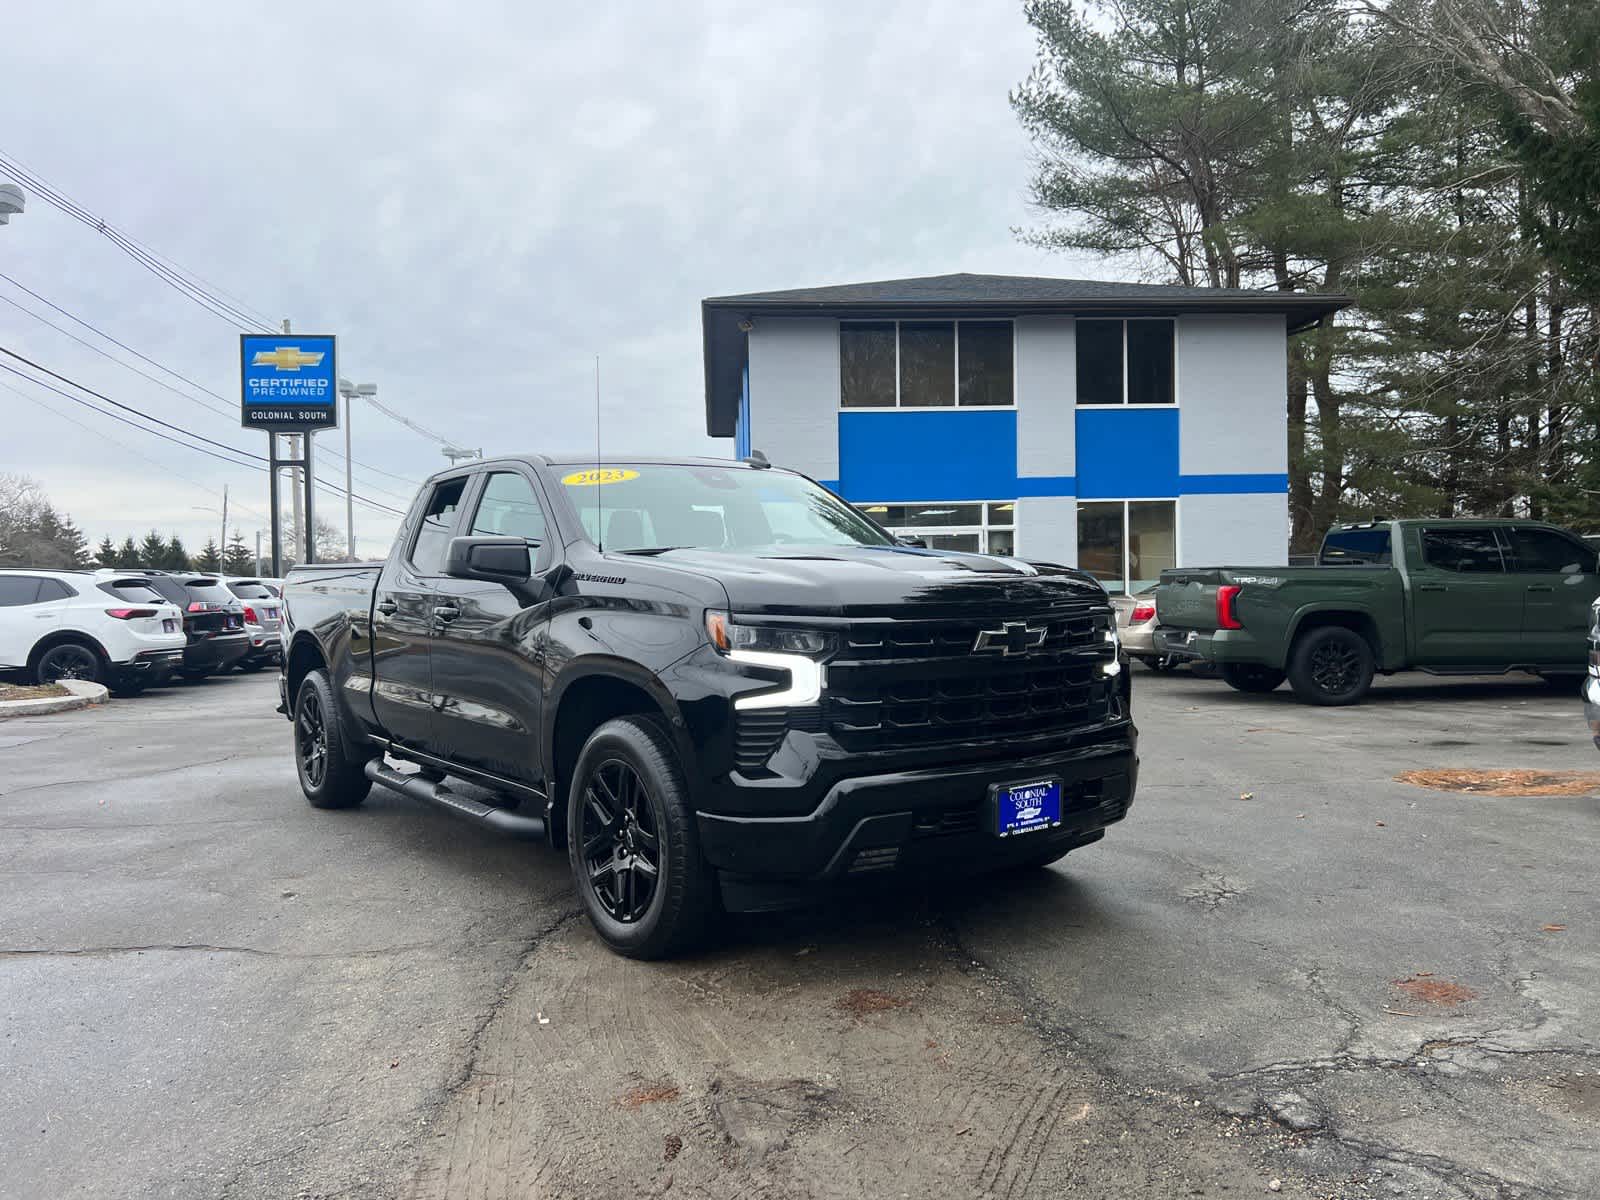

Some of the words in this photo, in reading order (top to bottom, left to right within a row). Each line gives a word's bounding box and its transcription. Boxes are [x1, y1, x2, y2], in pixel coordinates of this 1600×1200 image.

[248, 378, 329, 388] CERTIFIED
[252, 387, 325, 396] PRE-OWNED
[251, 411, 295, 420] COLONIAL
[299, 411, 327, 420] SOUTH
[577, 469, 625, 484] 2023
[1009, 787, 1047, 802] COLONIAL
[1015, 797, 1042, 810] SOUTH
